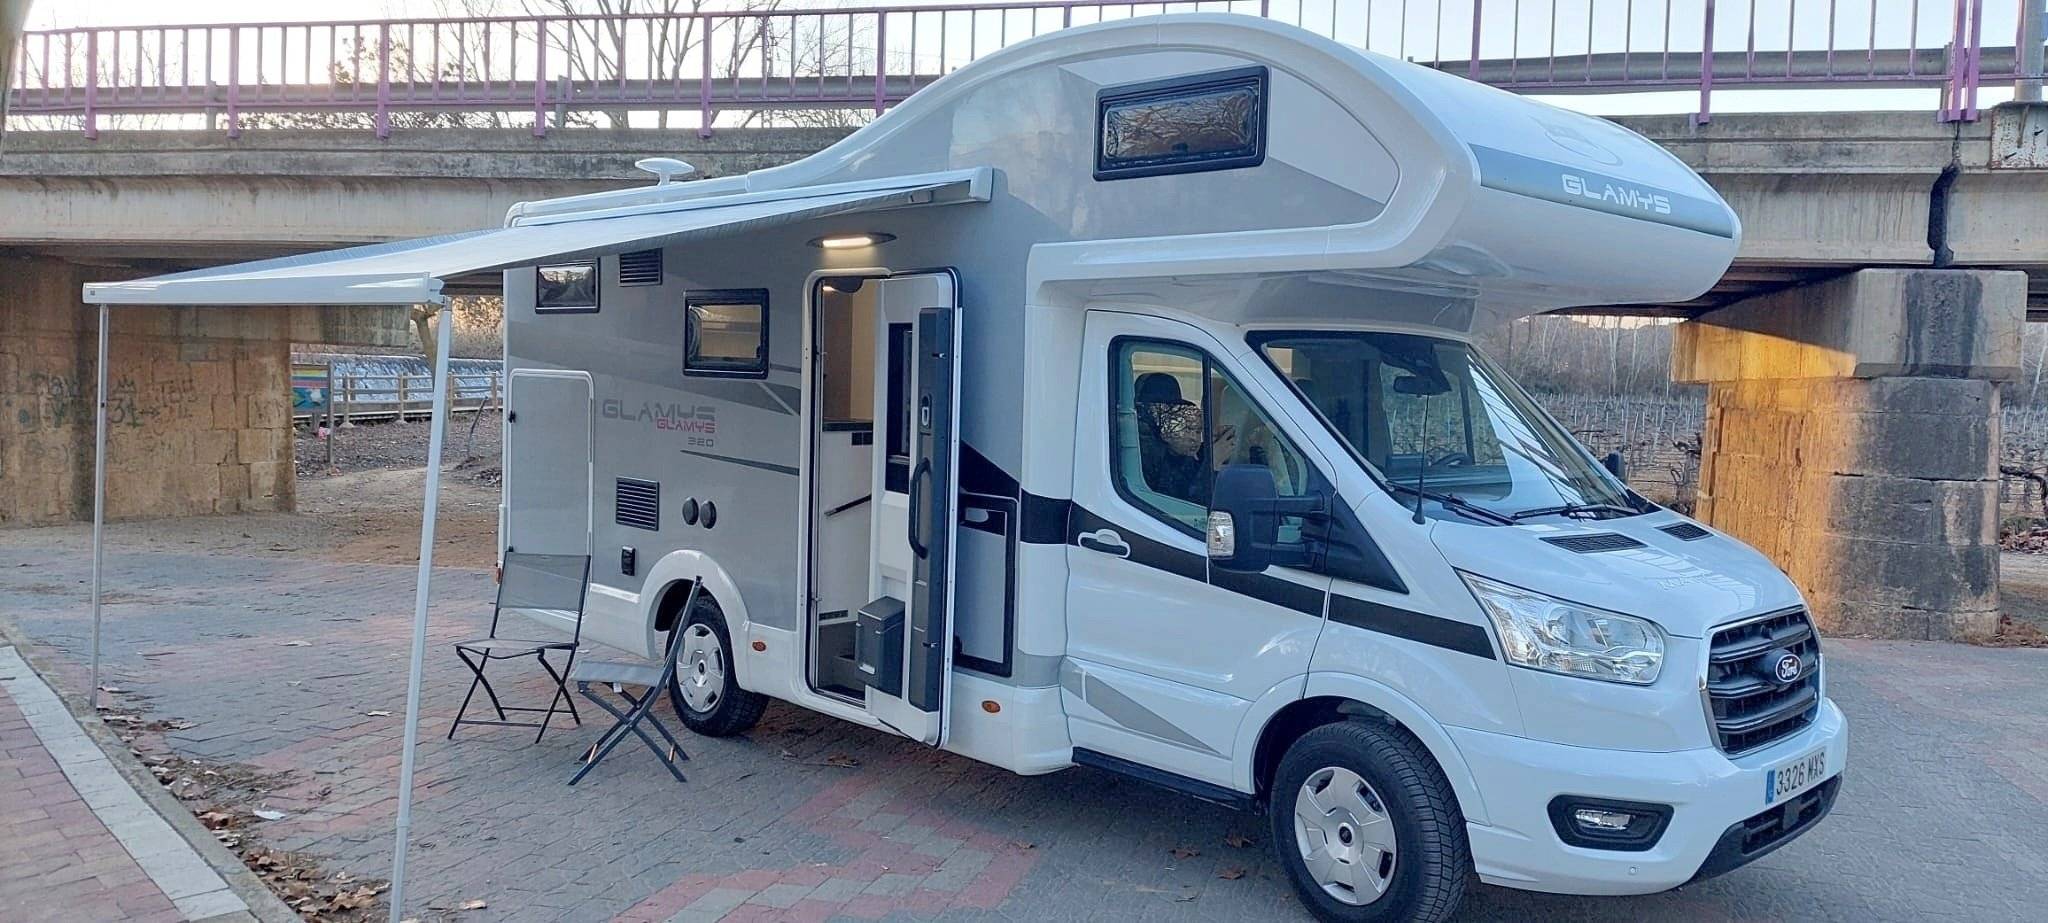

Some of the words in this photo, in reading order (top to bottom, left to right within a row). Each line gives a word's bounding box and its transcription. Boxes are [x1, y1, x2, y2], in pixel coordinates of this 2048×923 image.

[1561, 174, 1671, 215] GLAMYS
[602, 399, 716, 423] GLAMYS
[656, 418, 716, 434] GLAMYS
[687, 436, 714, 448] 320
[1780, 658, 1799, 679] Ford
[1776, 762, 1805, 796] 3326
[1807, 751, 1825, 783] MXS
